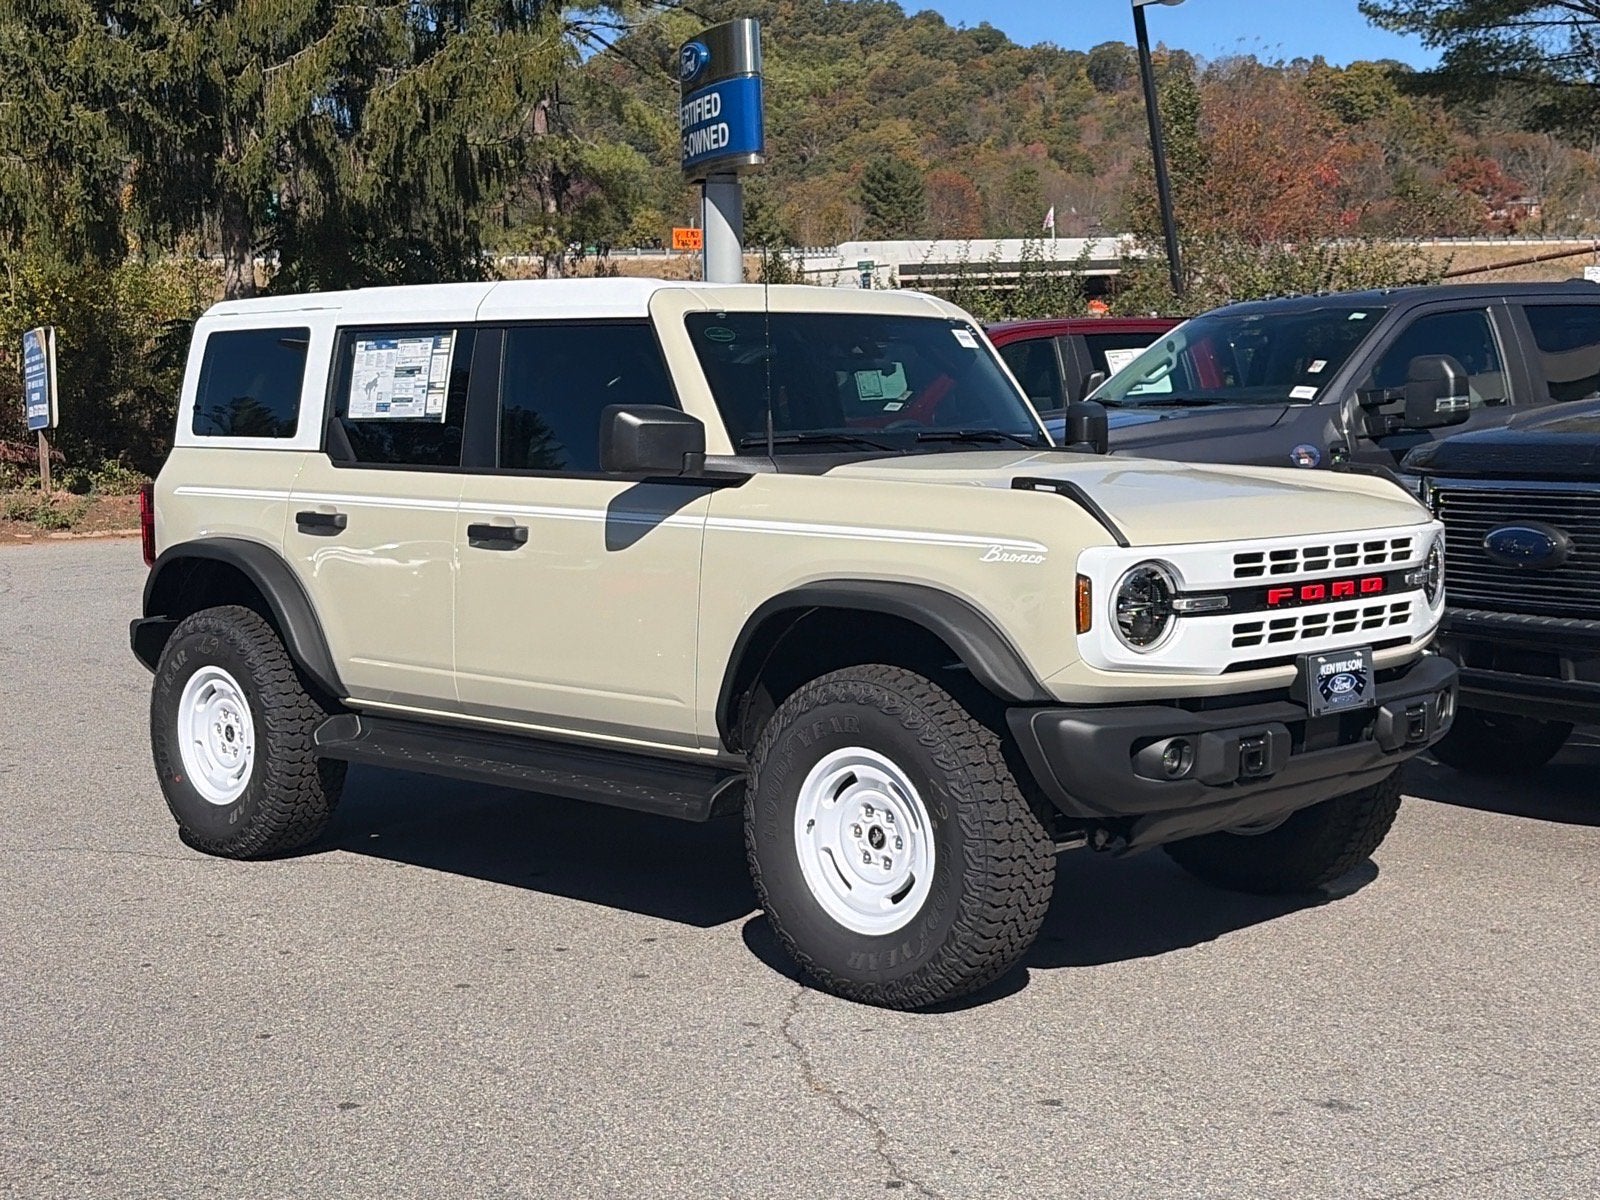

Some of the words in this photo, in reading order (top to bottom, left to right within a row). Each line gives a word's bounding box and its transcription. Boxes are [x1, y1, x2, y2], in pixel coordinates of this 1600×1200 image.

[680, 92, 721, 130] ERTIFIED
[683, 122, 729, 159] E-OWNED
[979, 544, 1046, 565] Bronco
[1267, 577, 1383, 604] FORD
[1320, 662, 1335, 676] KEN
[1335, 658, 1363, 673] WILSON
[1333, 676, 1352, 691] Ford
